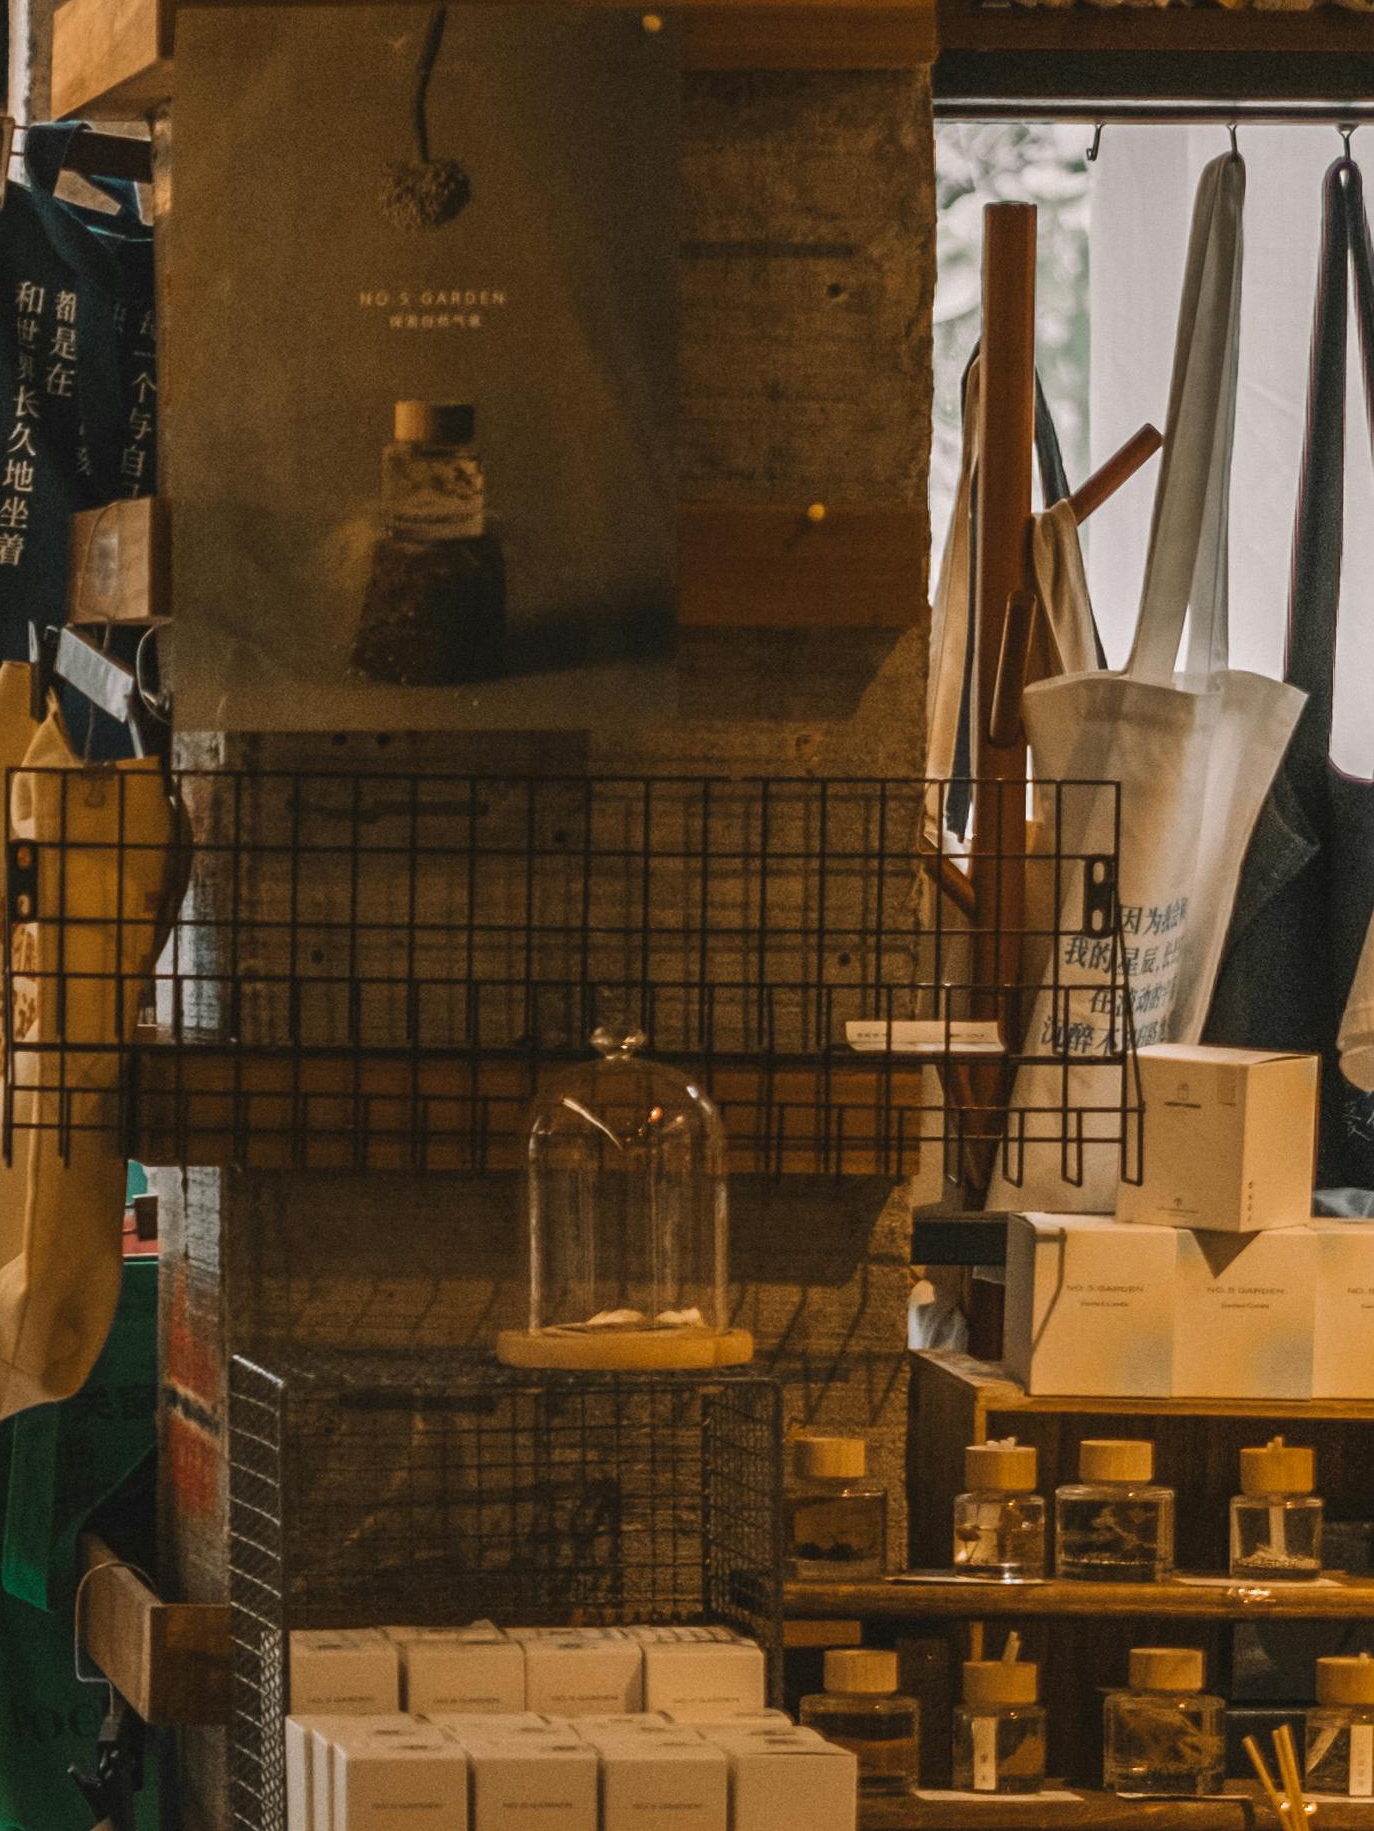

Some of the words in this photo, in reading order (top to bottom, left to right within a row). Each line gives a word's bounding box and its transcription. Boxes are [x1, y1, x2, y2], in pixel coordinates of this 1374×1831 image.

[420, 289, 507, 307] GARDEN
[46, 289, 78, 398] 都是在
